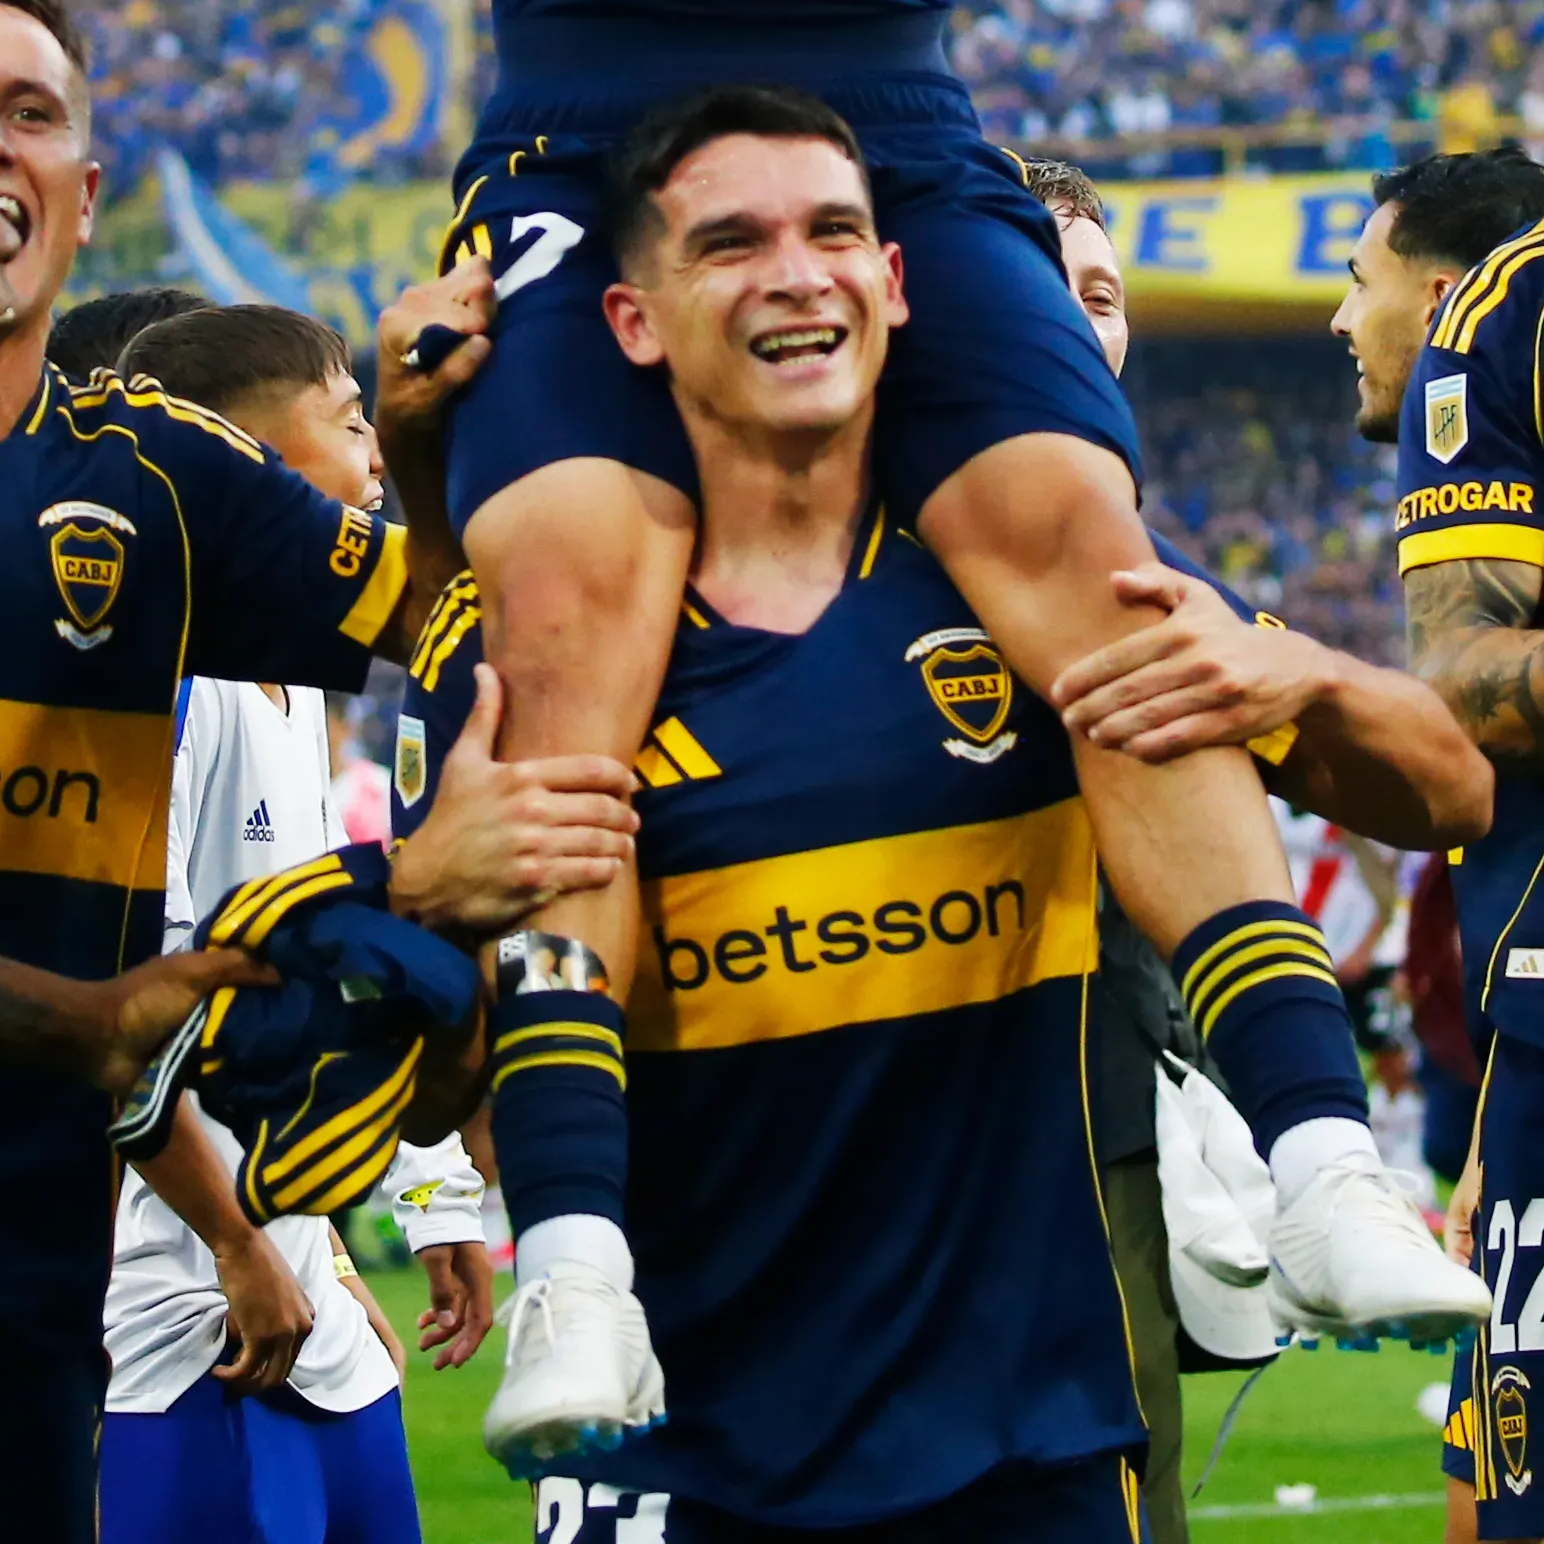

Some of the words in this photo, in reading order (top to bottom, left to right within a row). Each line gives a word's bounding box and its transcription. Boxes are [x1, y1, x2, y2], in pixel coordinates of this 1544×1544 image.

[65, 559, 112, 582] CABJ
[941, 677, 1000, 698] CABJ
[652, 877, 1027, 993] betsson
